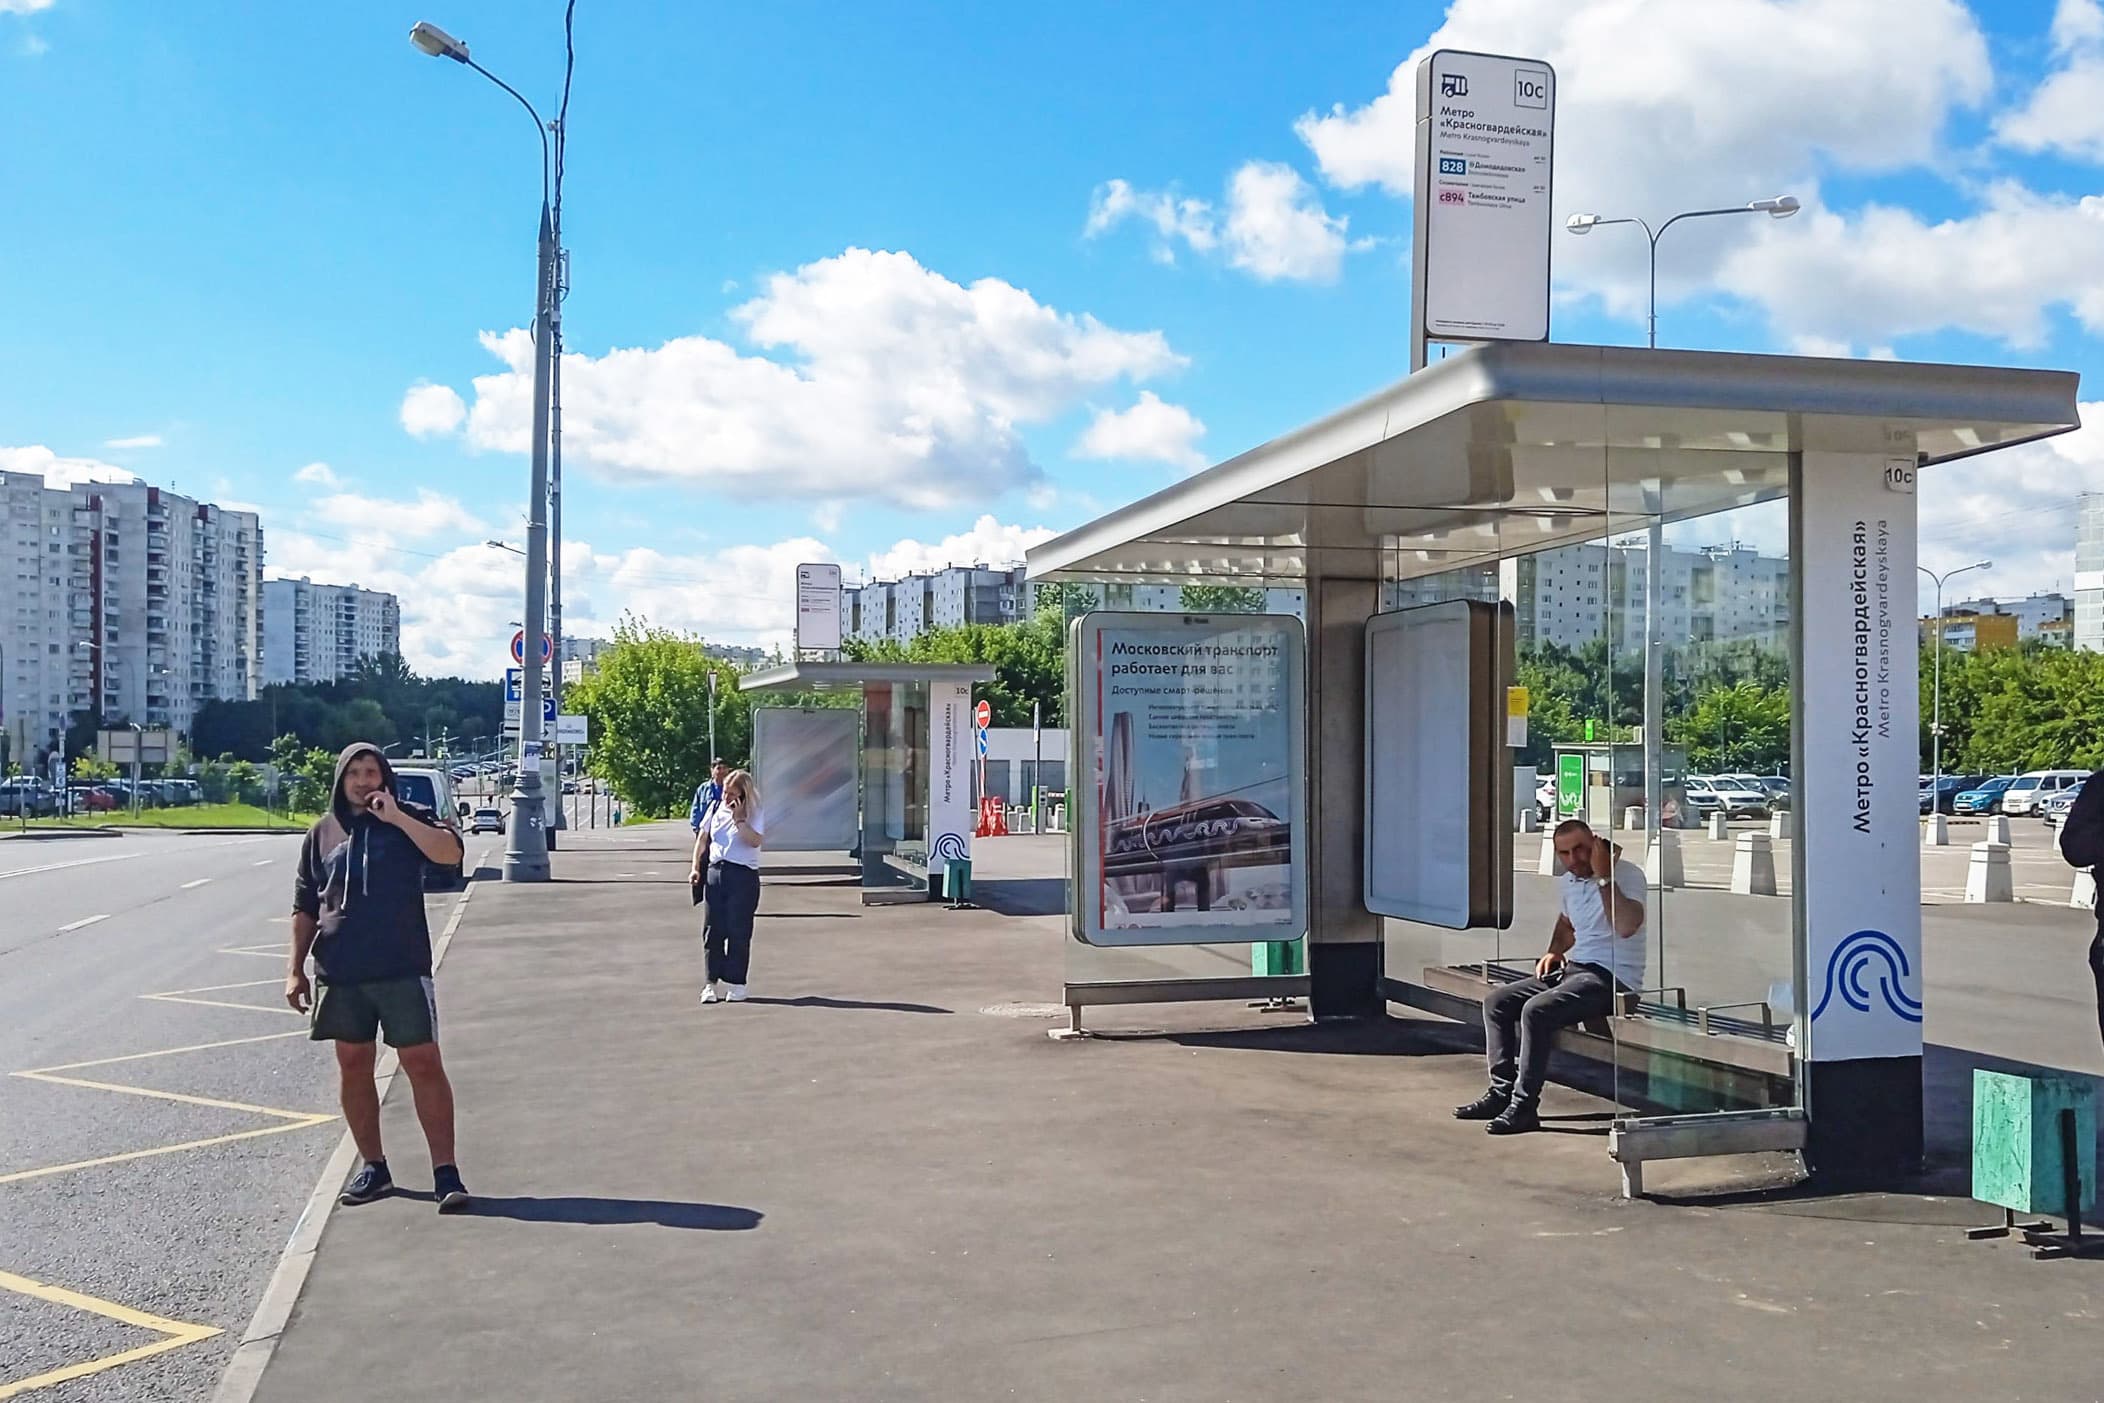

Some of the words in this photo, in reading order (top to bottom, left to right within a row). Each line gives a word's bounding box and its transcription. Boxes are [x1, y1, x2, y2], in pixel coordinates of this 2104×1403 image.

[1518, 81, 1544, 99] 10с
[1440, 106, 1475, 119] Метро
[1440, 119, 1547, 137] «Красногвардейская»
[1440, 131, 1462, 140] Metro
[1441, 160, 1464, 173] 828
[1440, 192, 1464, 203] с894
[1468, 191, 1506, 202] Тамбовская
[1885, 467, 1913, 484] 10с
[1876, 519, 1891, 684] Krasnogvardeyskaya
[1850, 520, 1873, 758] «Красногвардейская»
[1112, 642, 1203, 656] Московский
[1207, 645, 1278, 659] транспорт
[1112, 661, 1178, 677] работает
[1181, 664, 1207, 676] для
[1210, 664, 1234, 675] вас
[1112, 685, 1162, 697] Доступные
[1877, 688, 1890, 738] Metro
[1853, 761, 1874, 834] Метро
